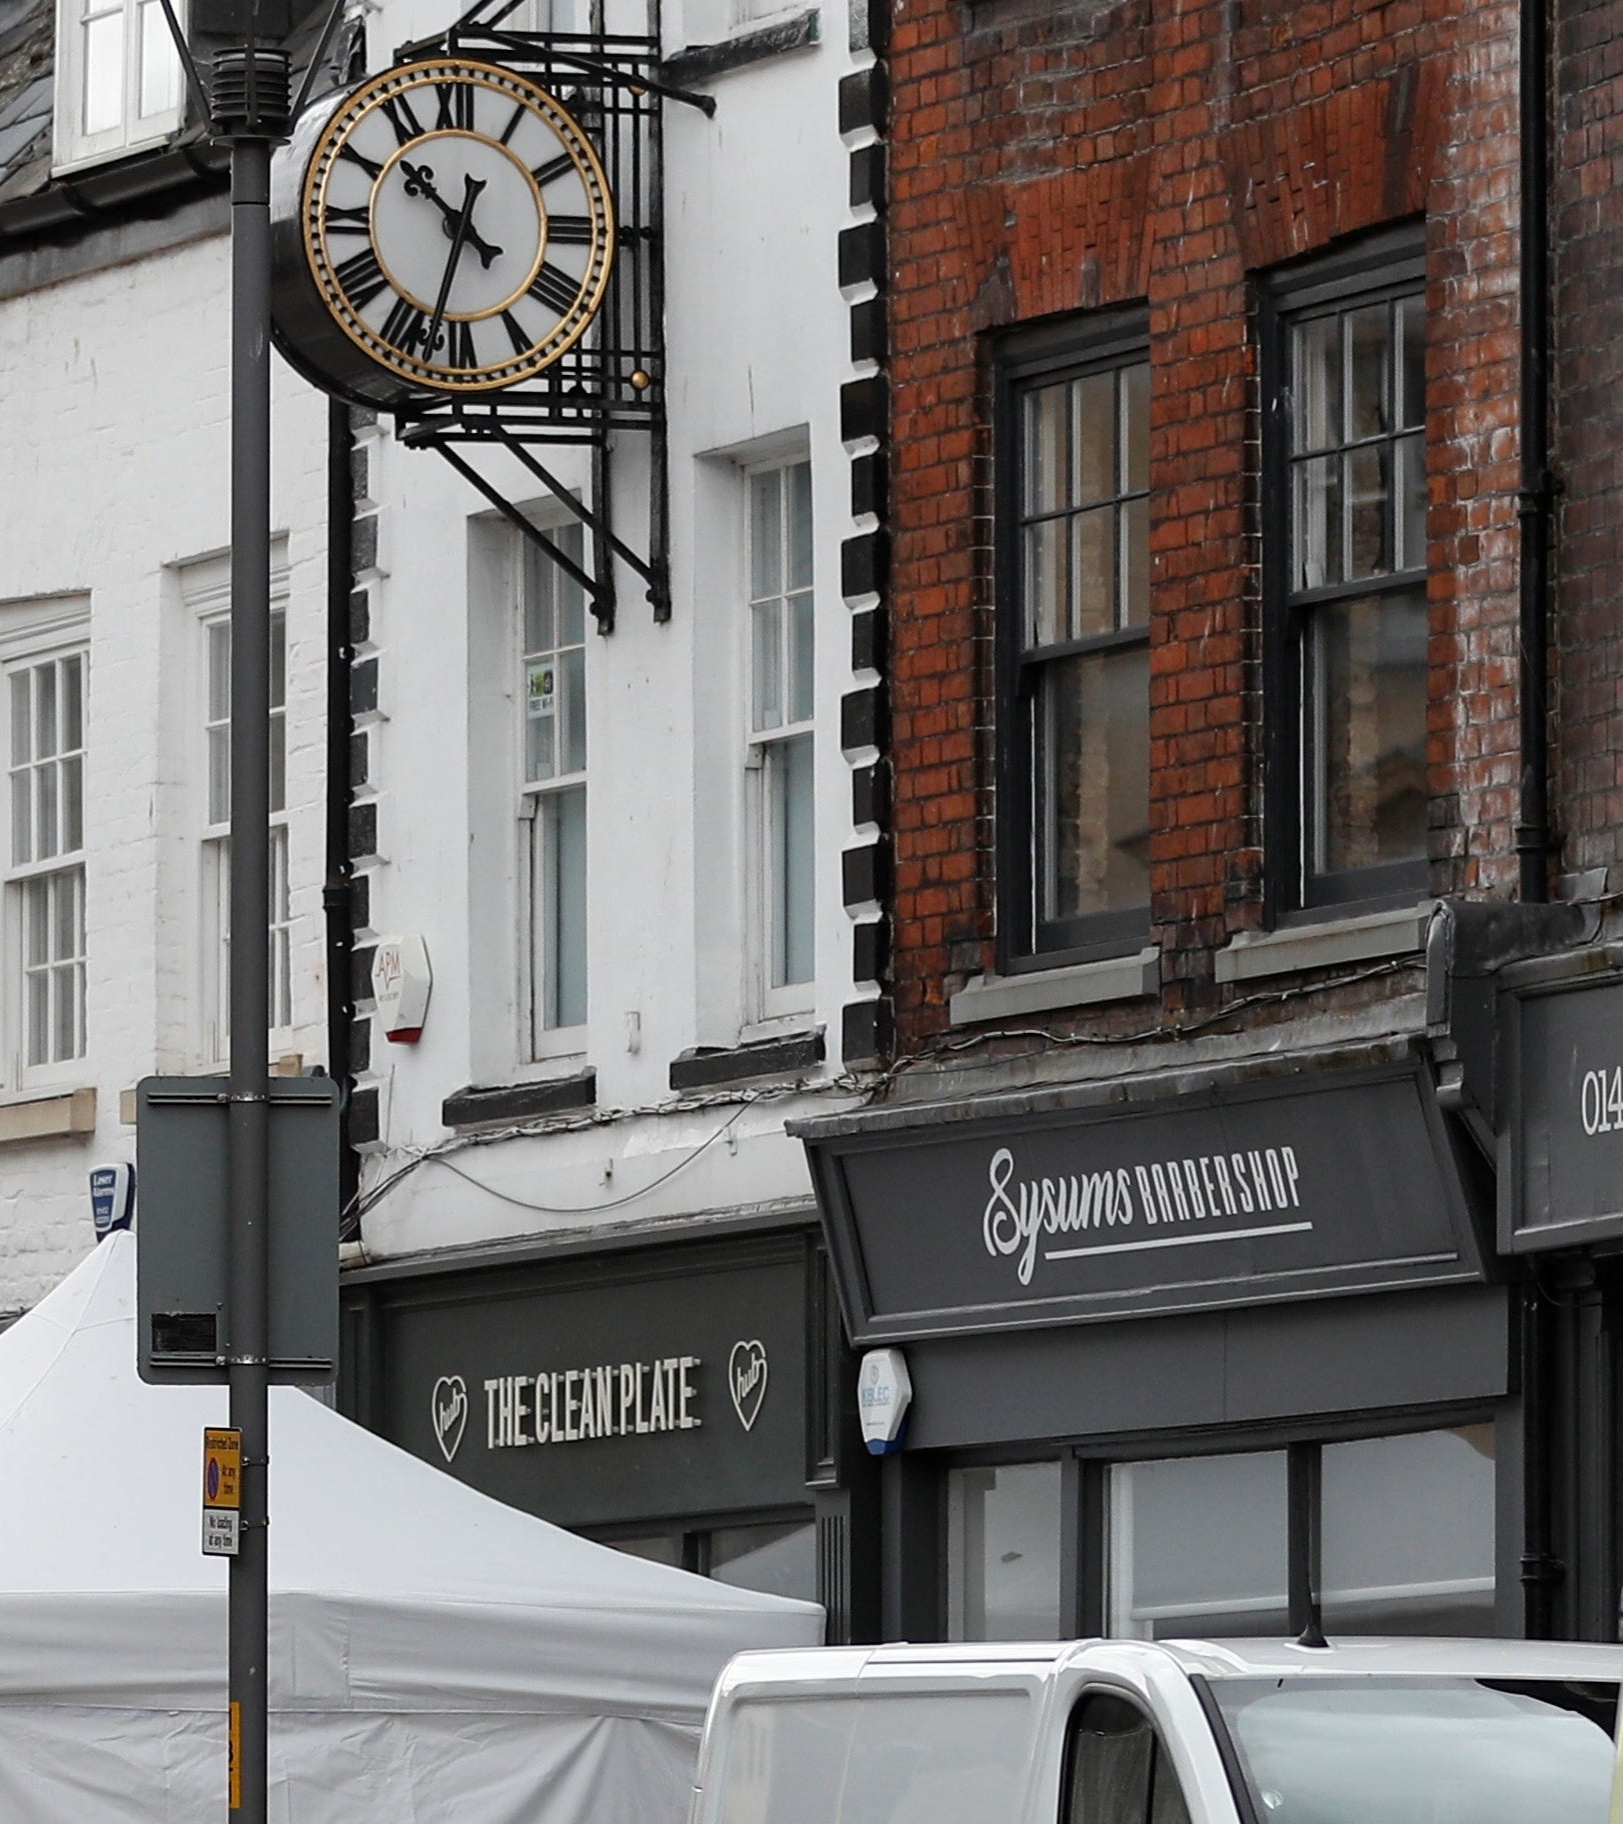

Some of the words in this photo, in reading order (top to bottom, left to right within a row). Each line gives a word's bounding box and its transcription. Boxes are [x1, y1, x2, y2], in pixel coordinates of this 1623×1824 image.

[983, 1147, 1134, 1287] Sysums
[1134, 1146, 1300, 1225] BARBERSHOP
[484, 1376, 528, 1449] THE
[535, 1364, 613, 1444] CLEAN
[620, 1356, 695, 1436] PLATE
